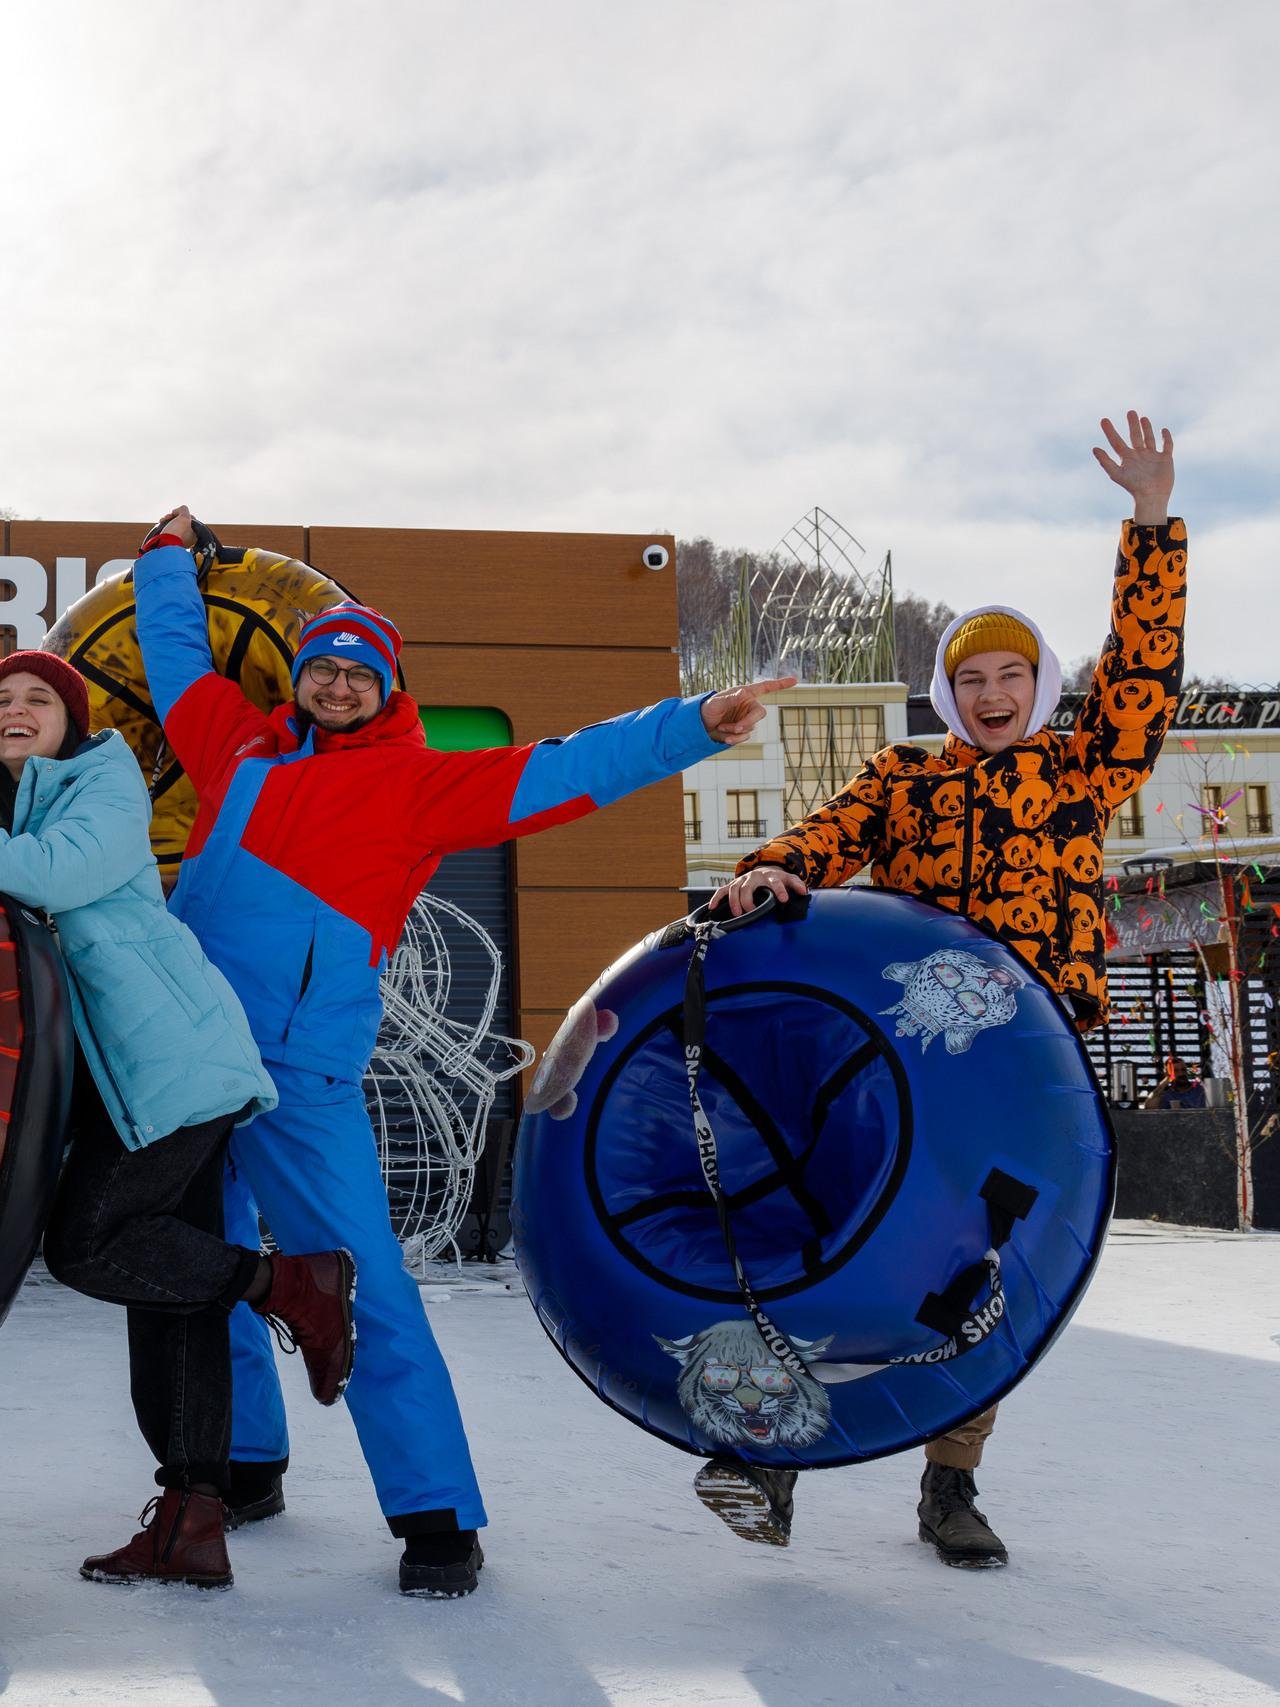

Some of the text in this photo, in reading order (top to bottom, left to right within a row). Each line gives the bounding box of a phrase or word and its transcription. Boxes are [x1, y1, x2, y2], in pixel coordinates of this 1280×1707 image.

[338, 631, 361, 644] NIKE
[780, 619, 874, 661] palace
[1175, 685, 1244, 725] ltai
[960, 1290, 1006, 1344] SHO
